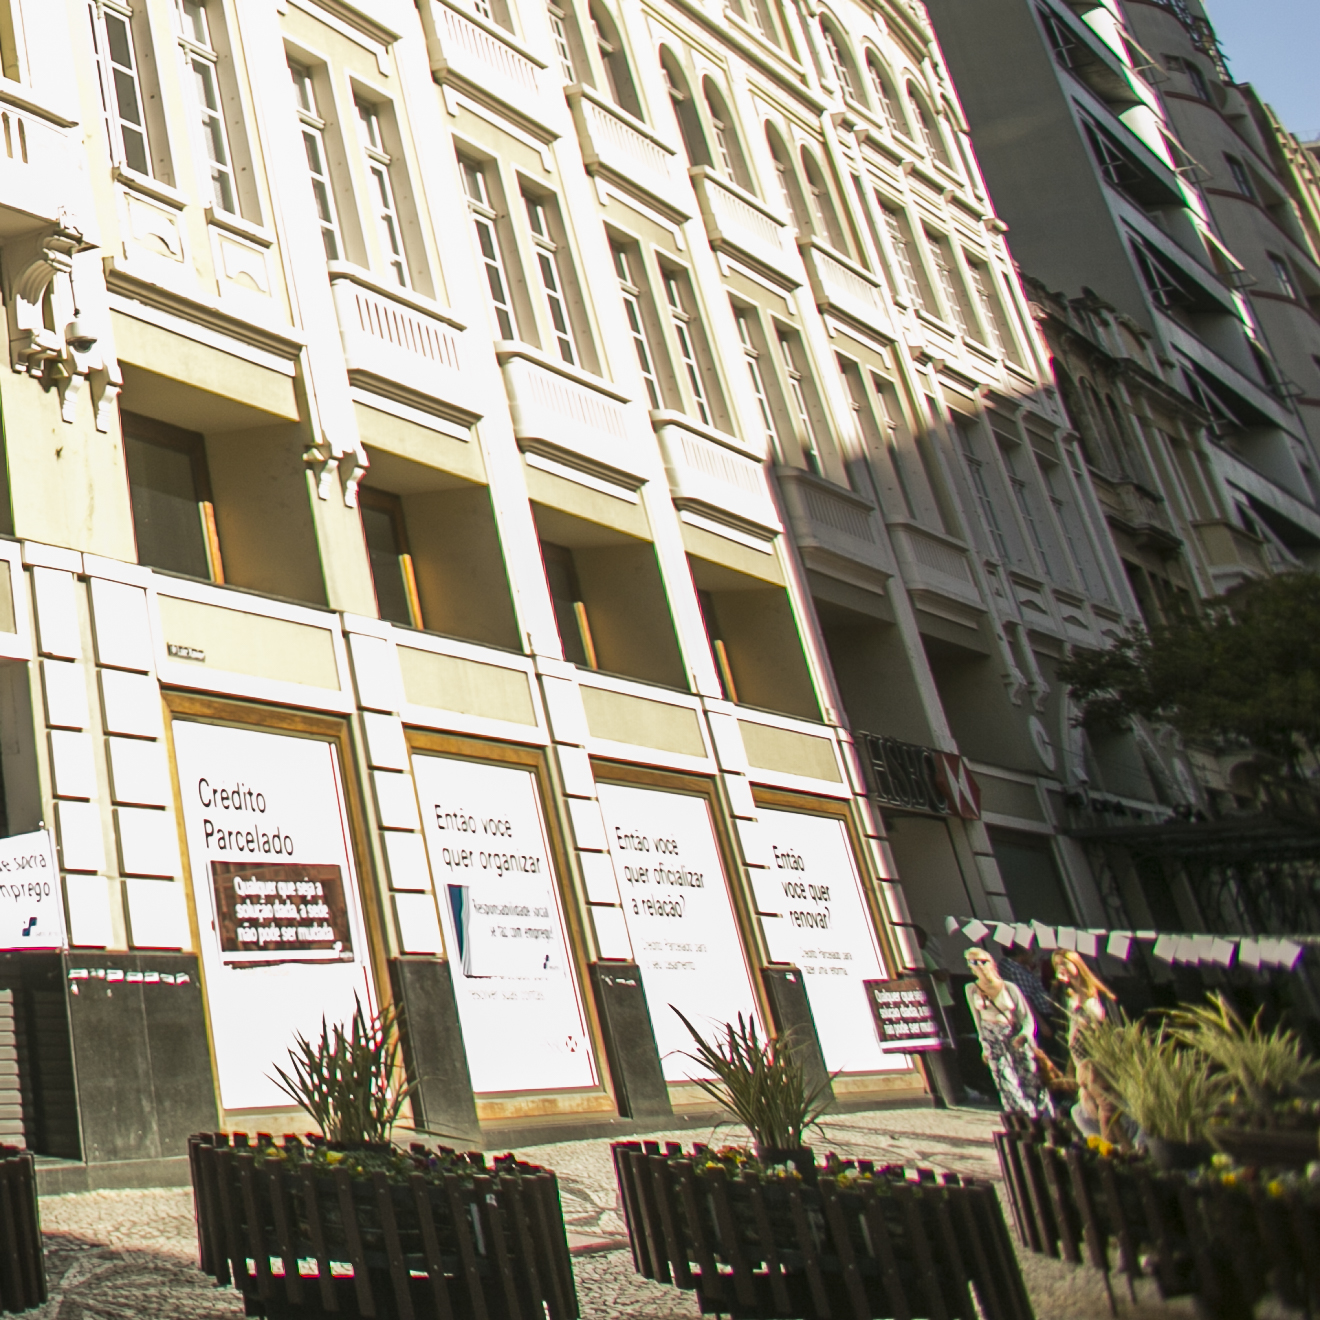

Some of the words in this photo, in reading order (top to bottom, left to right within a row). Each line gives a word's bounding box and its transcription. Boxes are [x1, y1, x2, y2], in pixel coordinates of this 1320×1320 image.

[859, 730, 948, 814] HSBC
[198, 777, 266, 814] Crédito
[434, 804, 477, 833] Então
[481, 813, 512, 837] você
[203, 818, 294, 856] Parcelado
[615, 826, 650, 853] Então
[652, 834, 679, 856] você
[442, 847, 474, 872] quer
[479, 848, 541, 877] organizar
[772, 845, 805, 871] Então
[233, 876, 277, 899] Qualquer
[277, 881, 296, 899] que
[296, 877, 316, 900] seja
[315, 882, 323, 895] a
[624, 865, 650, 888] quer
[653, 862, 705, 888] oficializar
[781, 877, 807, 900] você
[808, 884, 831, 906] quer
[235, 899, 274, 922] solução
[273, 900, 300, 920] dada,
[300, 904, 307, 918] a
[307, 899, 329, 918] sede
[472, 898, 531, 917] Responsabilidade
[631, 898, 639, 915] a
[641, 893, 687, 921] relação?
[789, 906, 832, 930] renovar?
[237, 922, 258, 942] não
[258, 922, 281, 946] pode
[281, 927, 296, 941] ser
[297, 922, 334, 941] mudada
